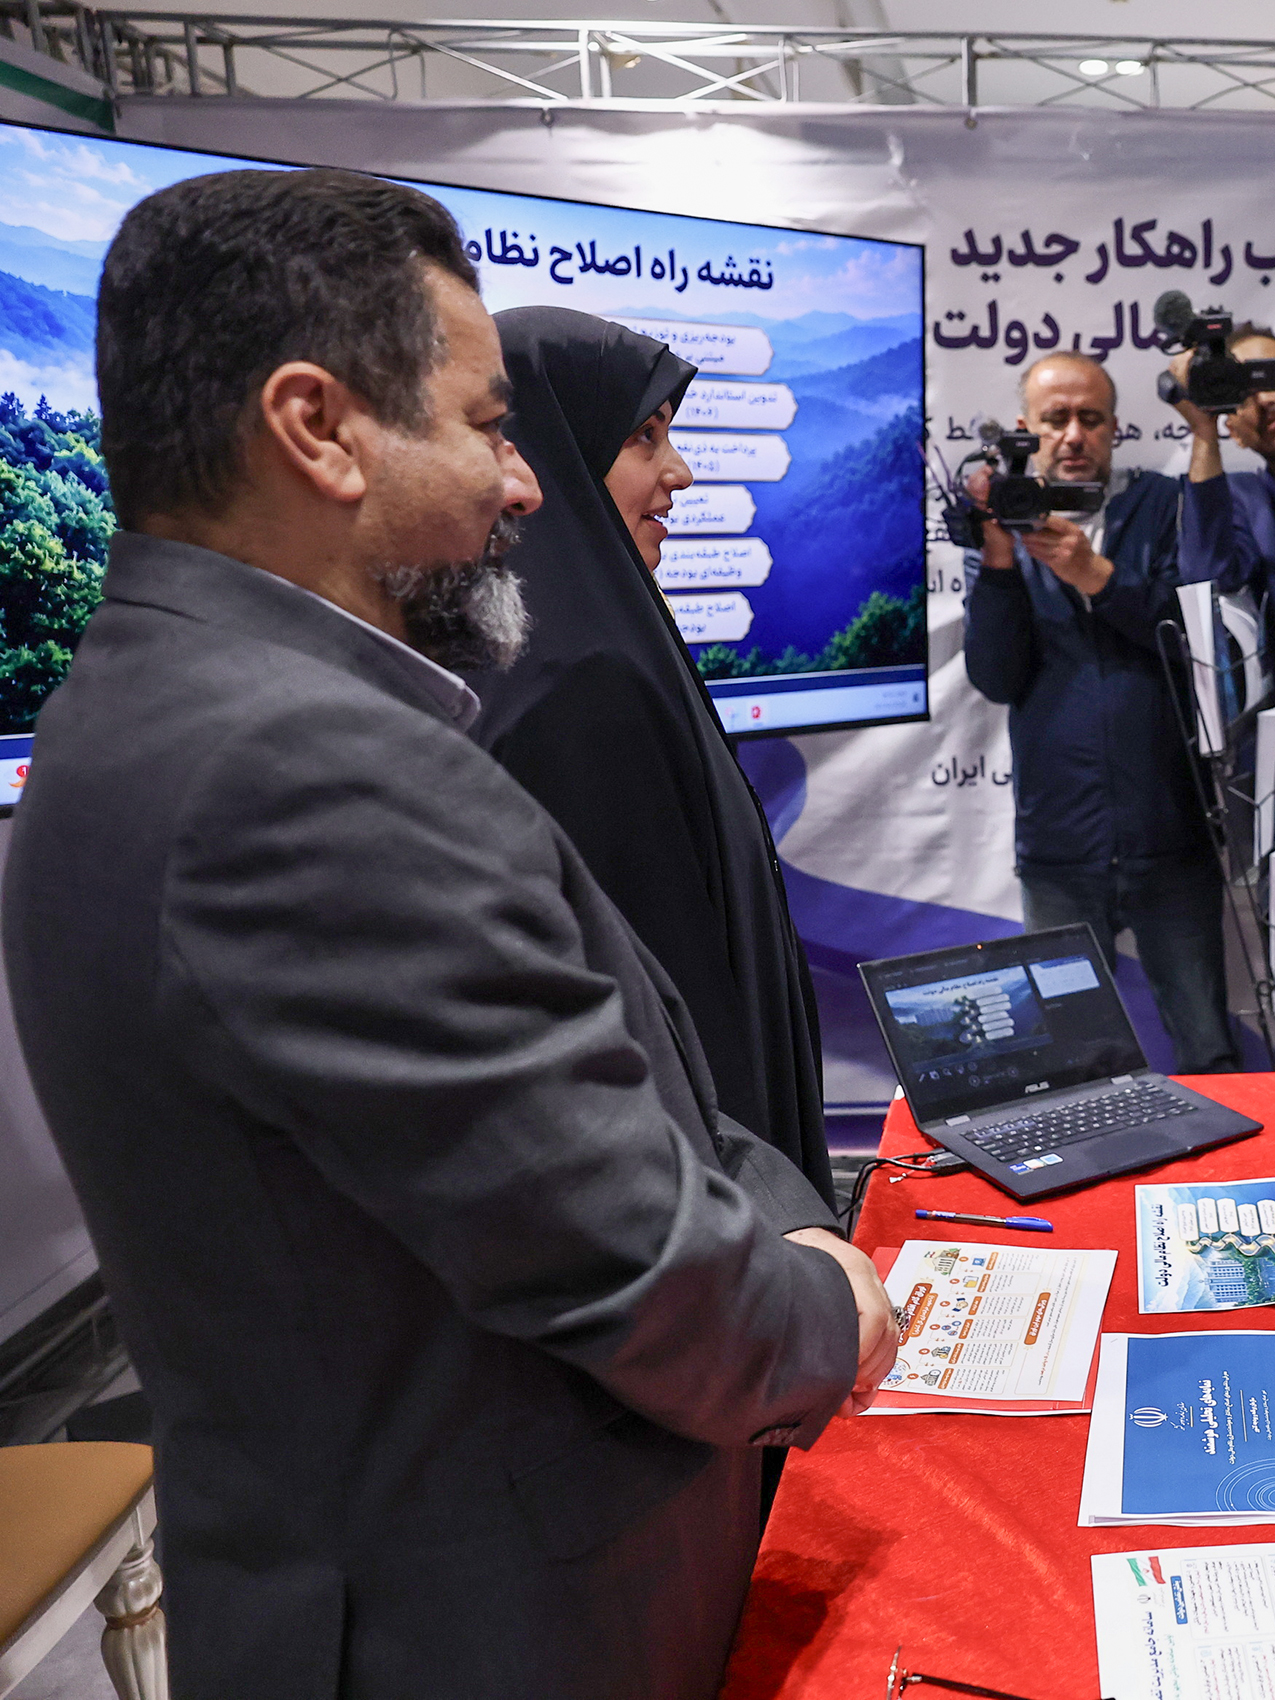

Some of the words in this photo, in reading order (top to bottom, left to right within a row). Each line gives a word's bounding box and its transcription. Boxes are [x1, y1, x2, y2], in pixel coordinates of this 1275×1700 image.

[465, 228, 540, 267] نظام
[549, 241, 641, 284] اصلاح
[951, 229, 1080, 284] جدید
[1085, 218, 1232, 285] راهکار
[650, 250, 689, 293] راه
[698, 255, 774, 290] نقشه
[933, 301, 1060, 364] دولت
[931, 756, 985, 787] ایران
